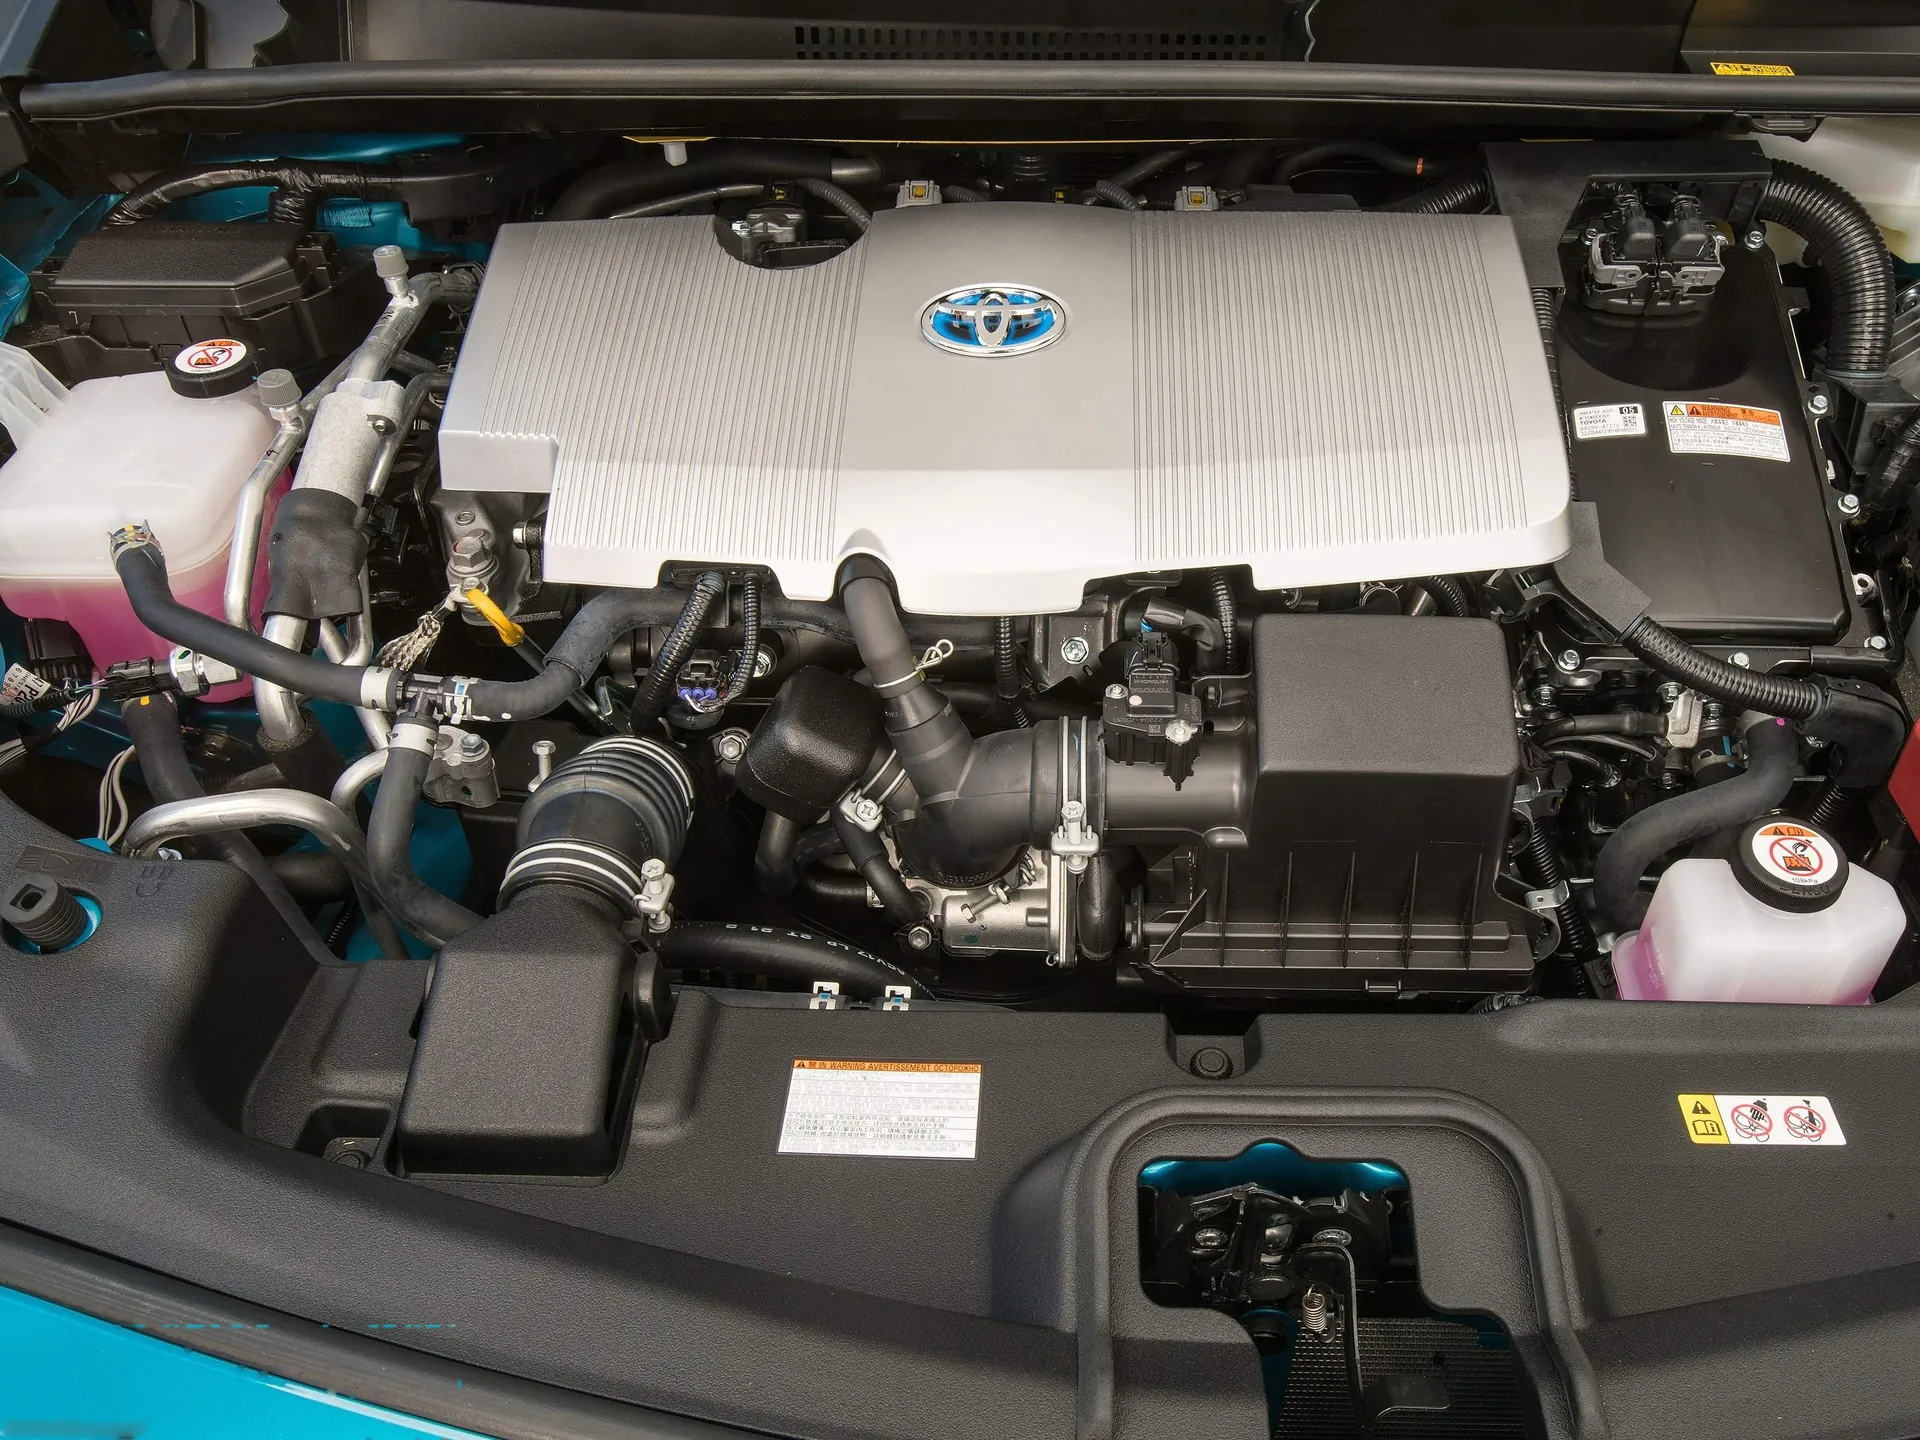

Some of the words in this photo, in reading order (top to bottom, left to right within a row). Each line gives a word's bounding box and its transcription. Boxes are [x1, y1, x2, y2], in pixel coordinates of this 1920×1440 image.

[1622, 406, 1635, 414] 05
[1701, 404, 1731, 413] WARNING
[1781, 882, 1831, 896] DENSO
[829, 1062, 866, 1070] WARNING
[867, 1062, 931, 1072] AVERTISSEMENT
